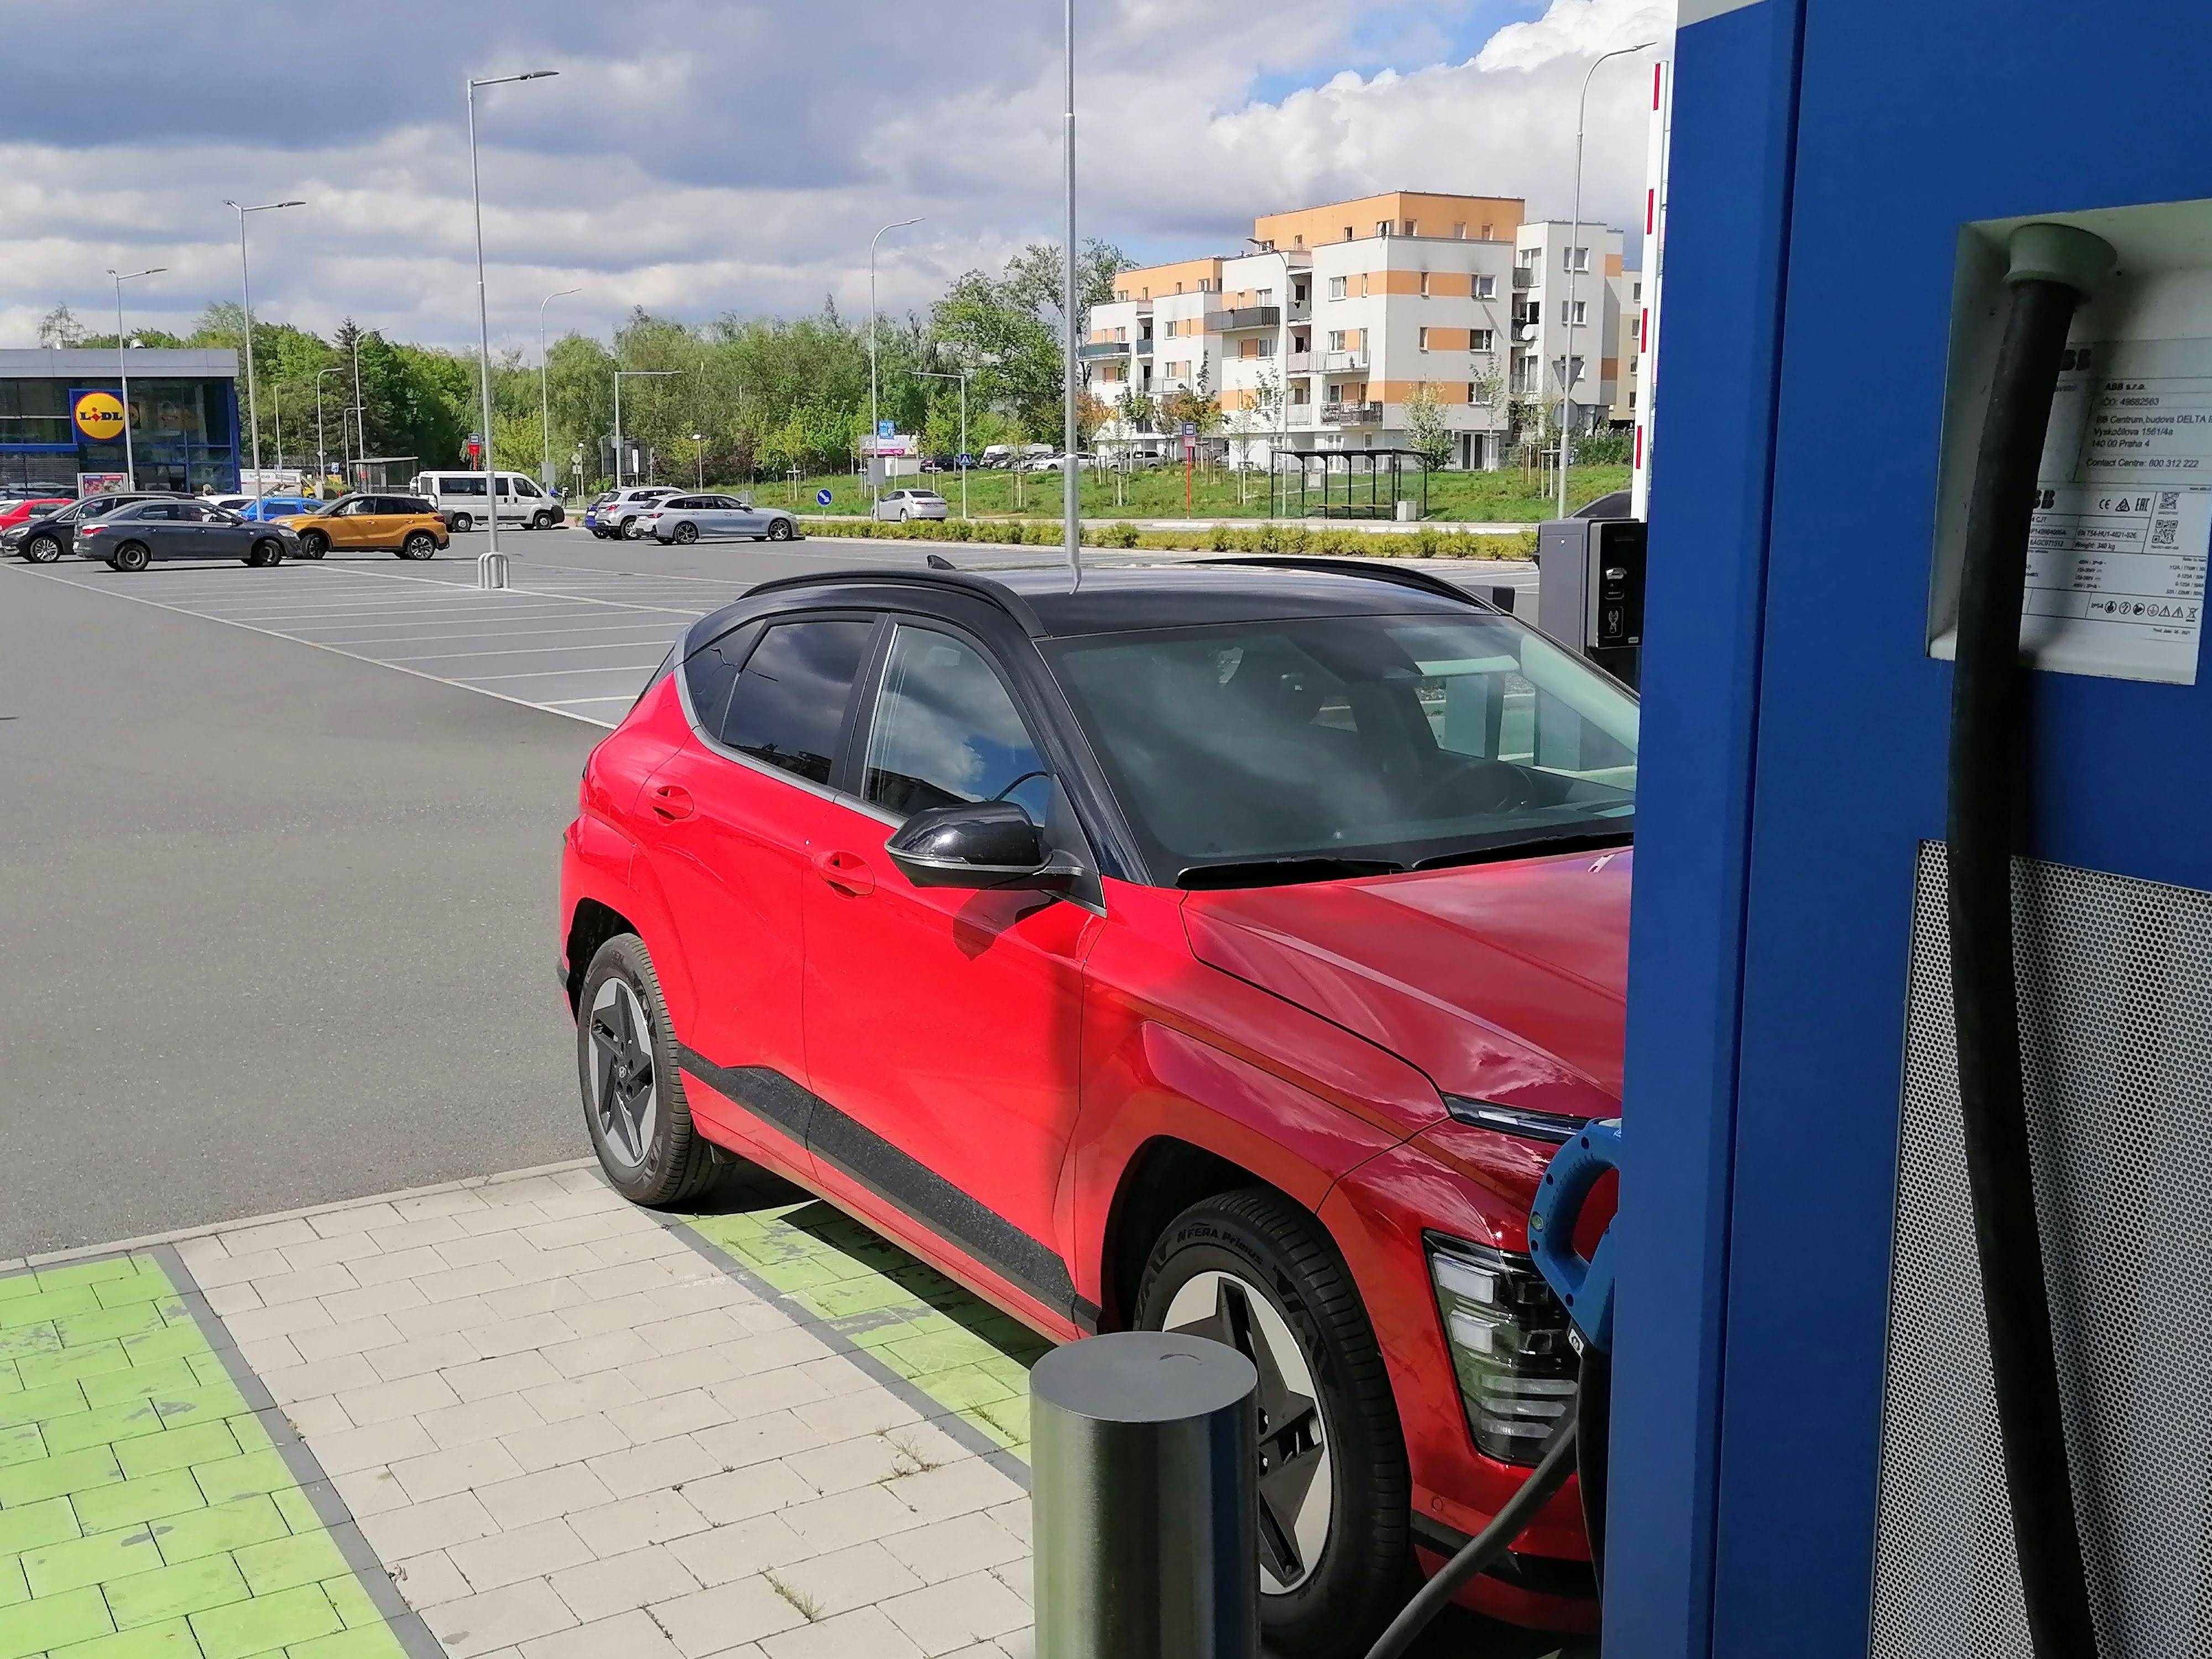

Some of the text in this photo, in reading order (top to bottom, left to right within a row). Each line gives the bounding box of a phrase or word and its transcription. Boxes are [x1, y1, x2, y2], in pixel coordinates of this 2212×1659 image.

[2104, 382, 2124, 390] ABB
[2177, 415, 2206, 424] DELTA
[2119, 440, 2143, 448] Praha
[2086, 458, 2116, 467] Contact
[2166, 460, 2181, 468] 312
[2183, 460, 2199, 468] 222
[1222, 1232, 1264, 1265] Primus
